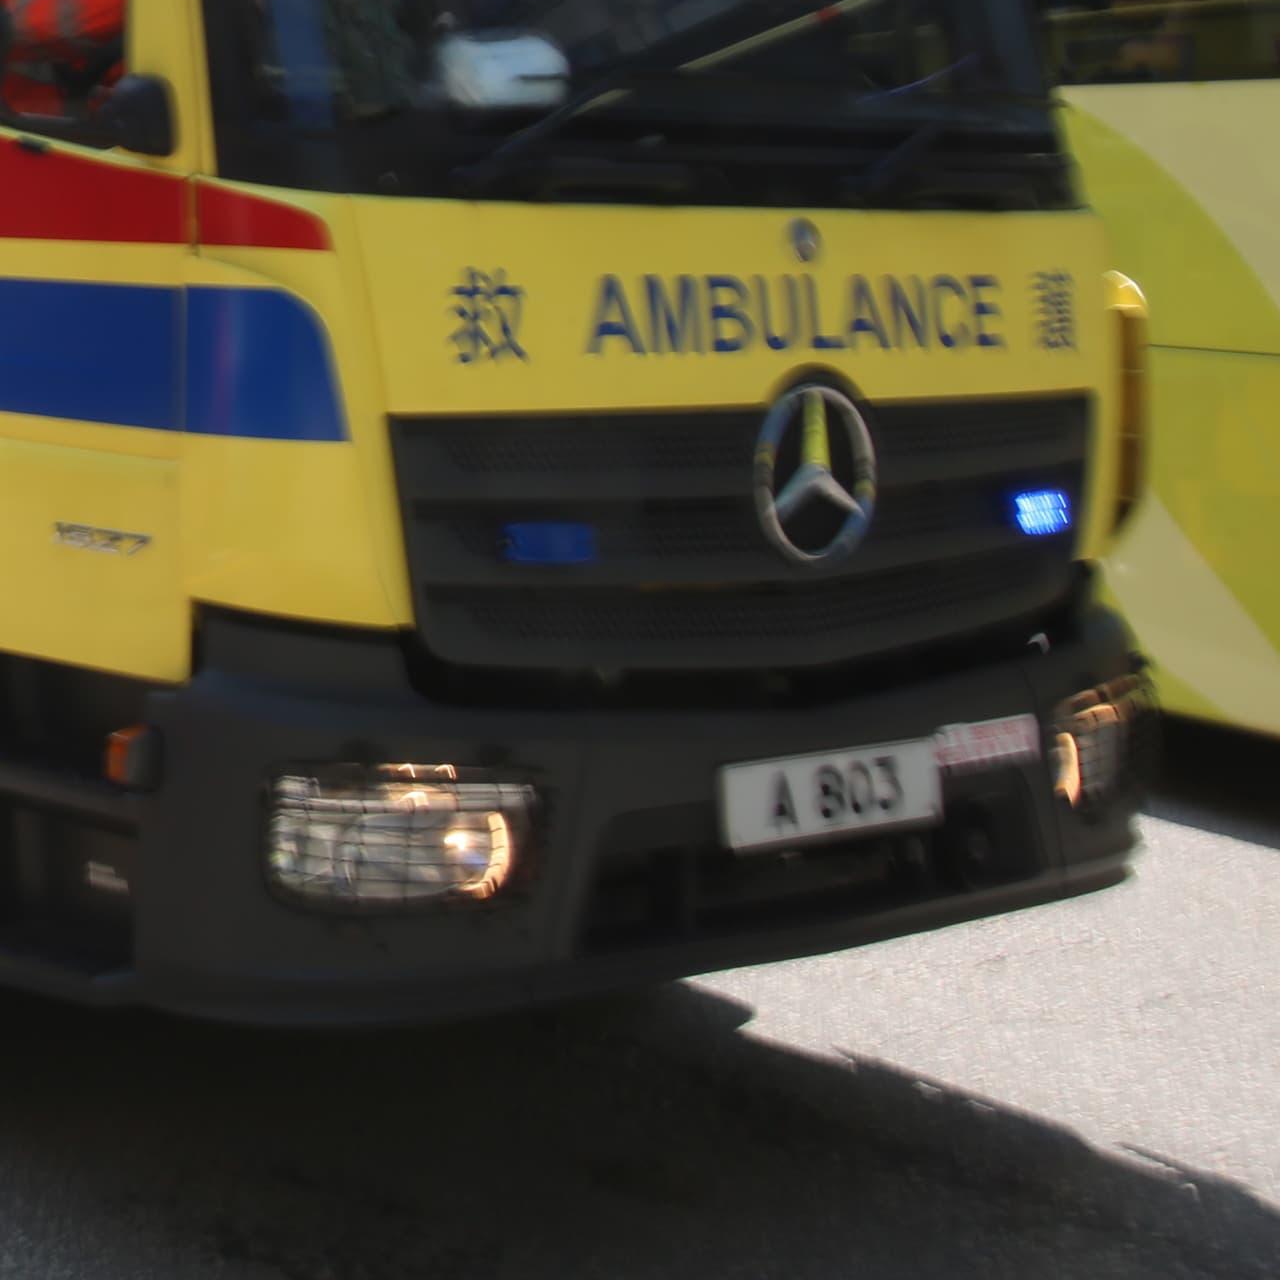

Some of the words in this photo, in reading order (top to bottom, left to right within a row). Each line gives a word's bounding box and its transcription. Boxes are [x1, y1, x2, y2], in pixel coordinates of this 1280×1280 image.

[447, 265, 530, 365] 救
[584, 272, 1005, 356] AMBULANCE
[767, 770, 799, 829] A
[814, 755, 904, 819] 803
